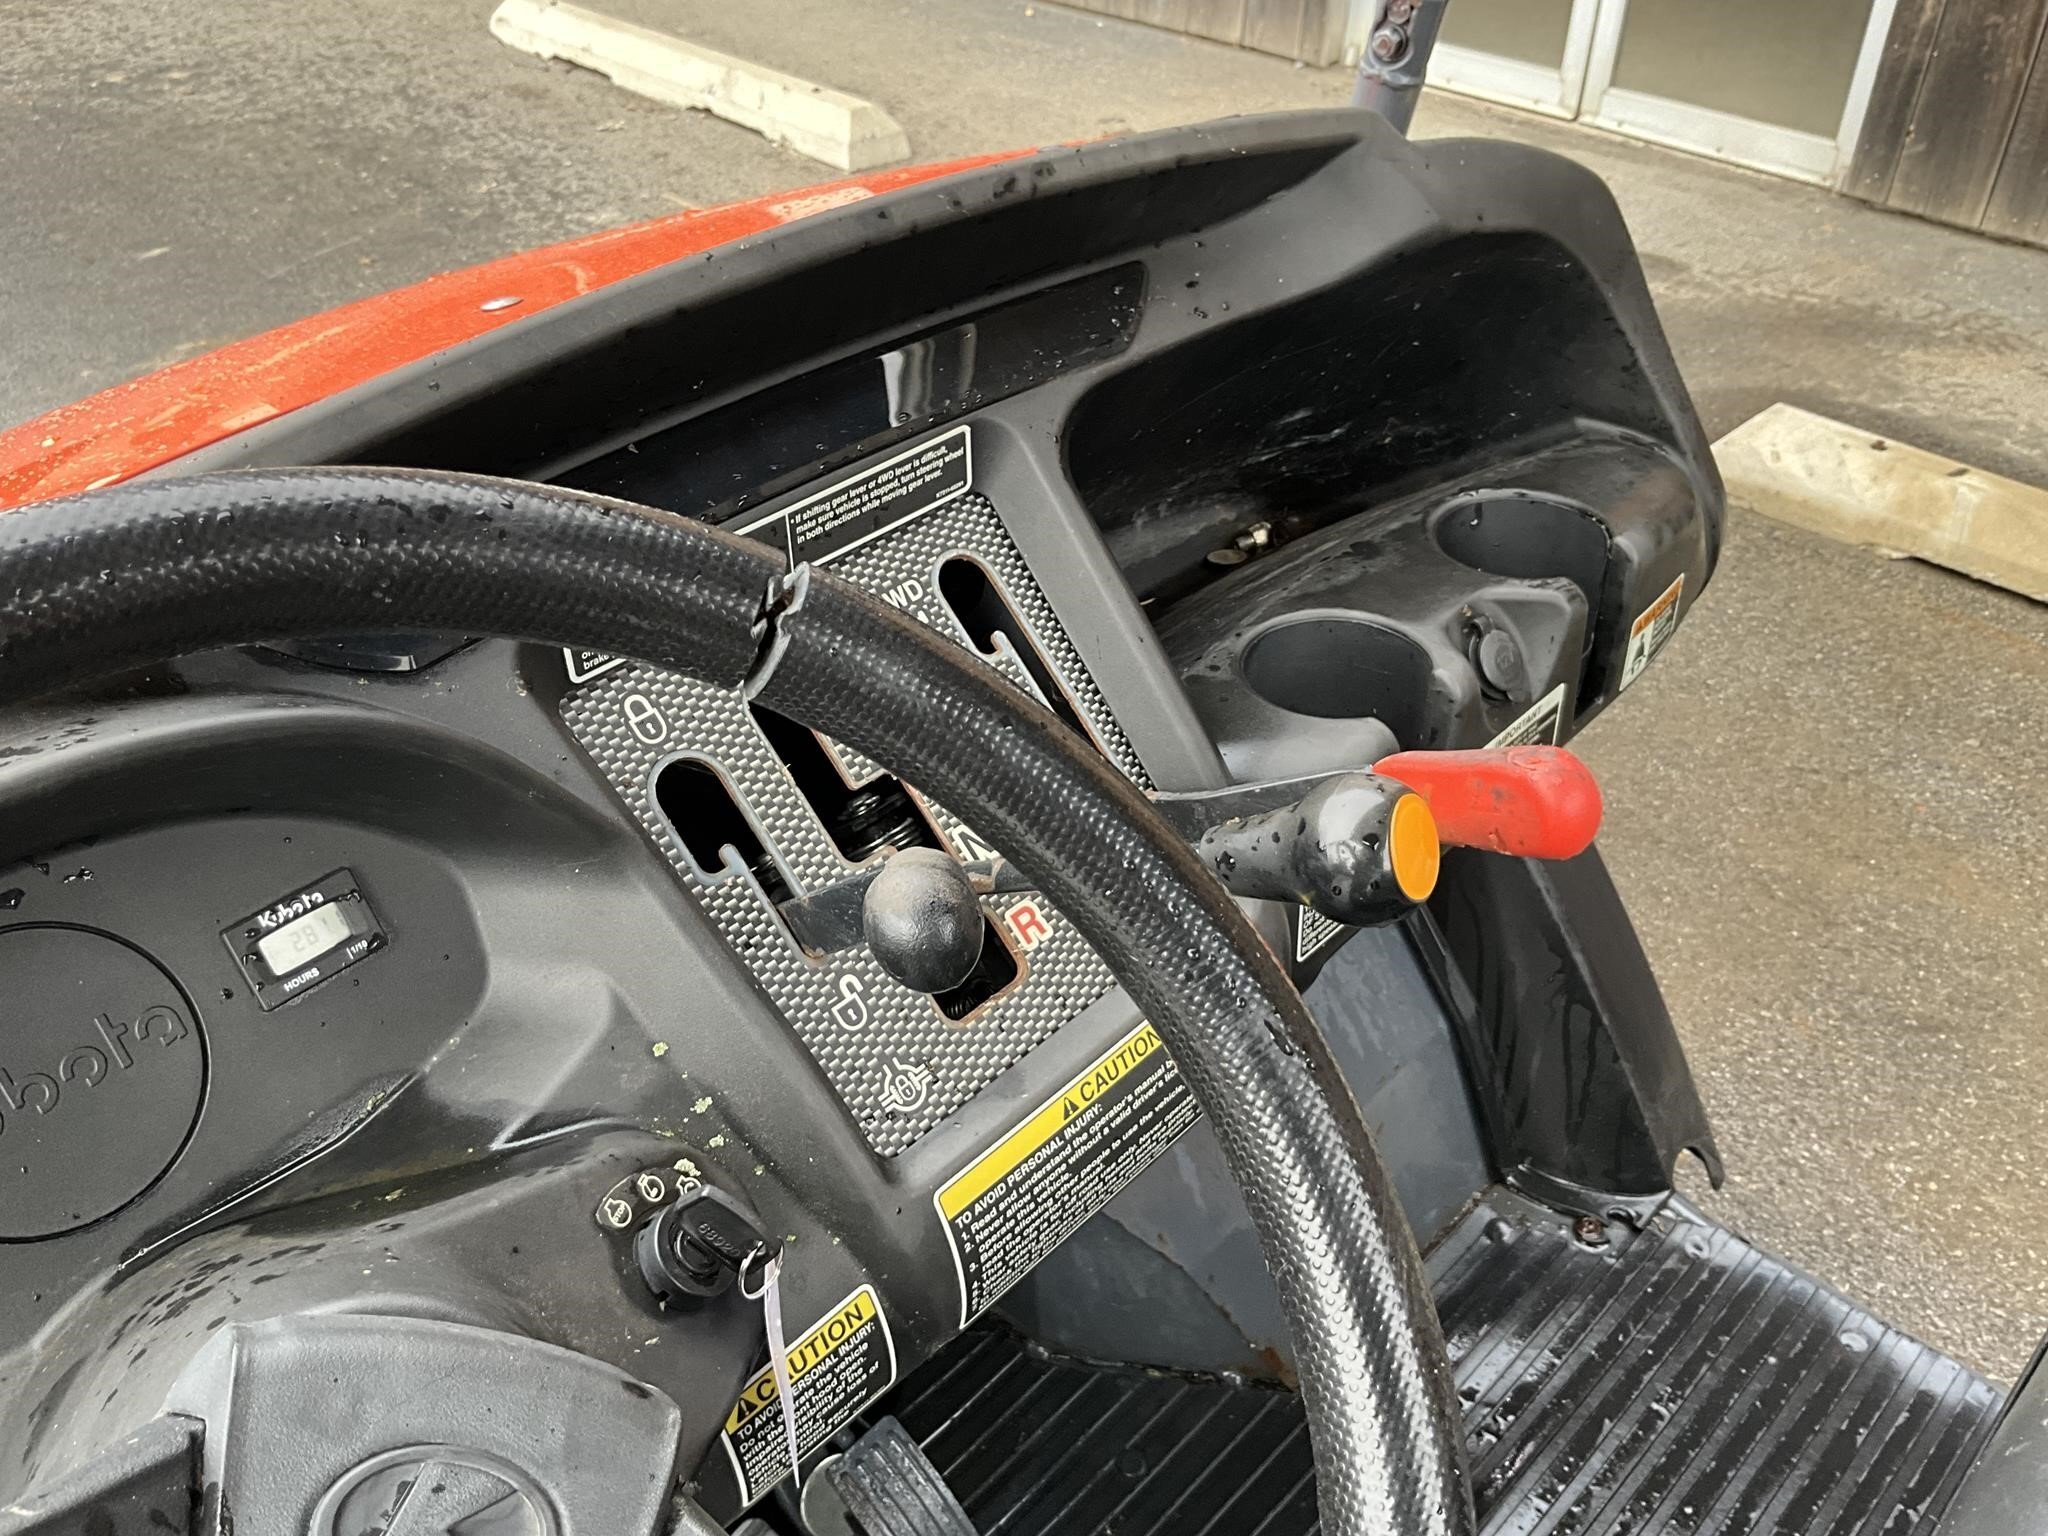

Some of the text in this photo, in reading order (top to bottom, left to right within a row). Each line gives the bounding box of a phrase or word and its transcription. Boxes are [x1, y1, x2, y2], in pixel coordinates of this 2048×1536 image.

[795, 514, 801, 523] If
[803, 502, 831, 520] shifting
[831, 493, 848, 508] gear
[849, 484, 866, 498] lever
[868, 480, 876, 489] or
[877, 470, 894, 484] 4WD
[895, 463, 912, 476] lever
[913, 459, 920, 467] is
[796, 519, 816, 534] make
[818, 511, 834, 523] sure
[834, 498, 861, 515] vehicle
[862, 494, 869, 502] is
[901, 472, 915, 484] turn
[916, 458, 943, 477] steering
[944, 446, 964, 462] wheel
[797, 535, 805, 544] in
[806, 526, 823, 540] both
[824, 508, 860, 531] directions
[861, 499, 880, 513] while
[881, 486, 907, 503] moving
[908, 478, 923, 492] gear
[881, 580, 923, 608] WD
[257, 892, 324, 928] Kubota
[1008, 903, 1048, 947] R
[283, 967, 320, 991] HOURS
[0, 1005, 188, 1135] bota
[955, 1103, 1103, 1229] TO AVOID PERSONAL INJURY:
[961, 1232, 970, 1241] 1.
[971, 1206, 997, 1234] Read
[999, 1189, 1018, 1211] and
[1019, 1144, 1072, 1194] understand
[1072, 1132, 1088, 1148] the
[1089, 1094, 1133, 1134] operator's
[1134, 1064, 1165, 1096] manual
[964, 1080, 1164, 1253] 2. Never allow anyone without a valid driver's
[969, 1262, 979, 1272] 3.
[980, 1233, 1012, 1263] Before
[1014, 1197, 1053, 1234] allowing
[1055, 1174, 1079, 1199] other
[1080, 1148, 1110, 1179] people
[1111, 1139, 1121, 1150] to
[1122, 1124, 1138, 1141] use
[1139, 1111, 1153, 1126] the
[613, 1203, 626, 1223] STOP
[978, 1172, 1072, 1253] operate this vehicle.
[982, 1261, 1003, 1280] This
[1005, 1230, 1038, 1261] vehicle
[1040, 1221, 1048, 1231] is
[1050, 1208, 1063, 1222] for
[1065, 1195, 1077, 1209] off
[1079, 1176, 1099, 1198] road
[1139, 1120, 1163, 1144] Never
[982, 1249, 1004, 1272] read
[1005, 1235, 1021, 1251] the
[1023, 1194, 1069, 1236] operator's
[737, 1424, 753, 1439] TO
[791, 1346, 839, 1396] ERSONAL
[838, 1322, 875, 1357] INJURY:
[756, 1302, 863, 1401] CUTION
[816, 1392, 845, 1419] cause
[847, 1373, 867, 1393] loss
[869, 1361, 878, 1374] of
[836, 1380, 845, 1393] of
[847, 1367, 863, 1383] the
[739, 1342, 868, 1453] Do not orate the vehicle
[743, 1441, 765, 1461] with
[767, 1425, 784, 1441] the
[793, 1401, 810, 1419] ont
[811, 1377, 837, 1404] hood
[839, 1357, 866, 1383] open.
[750, 1447, 785, 1482] vehicle
